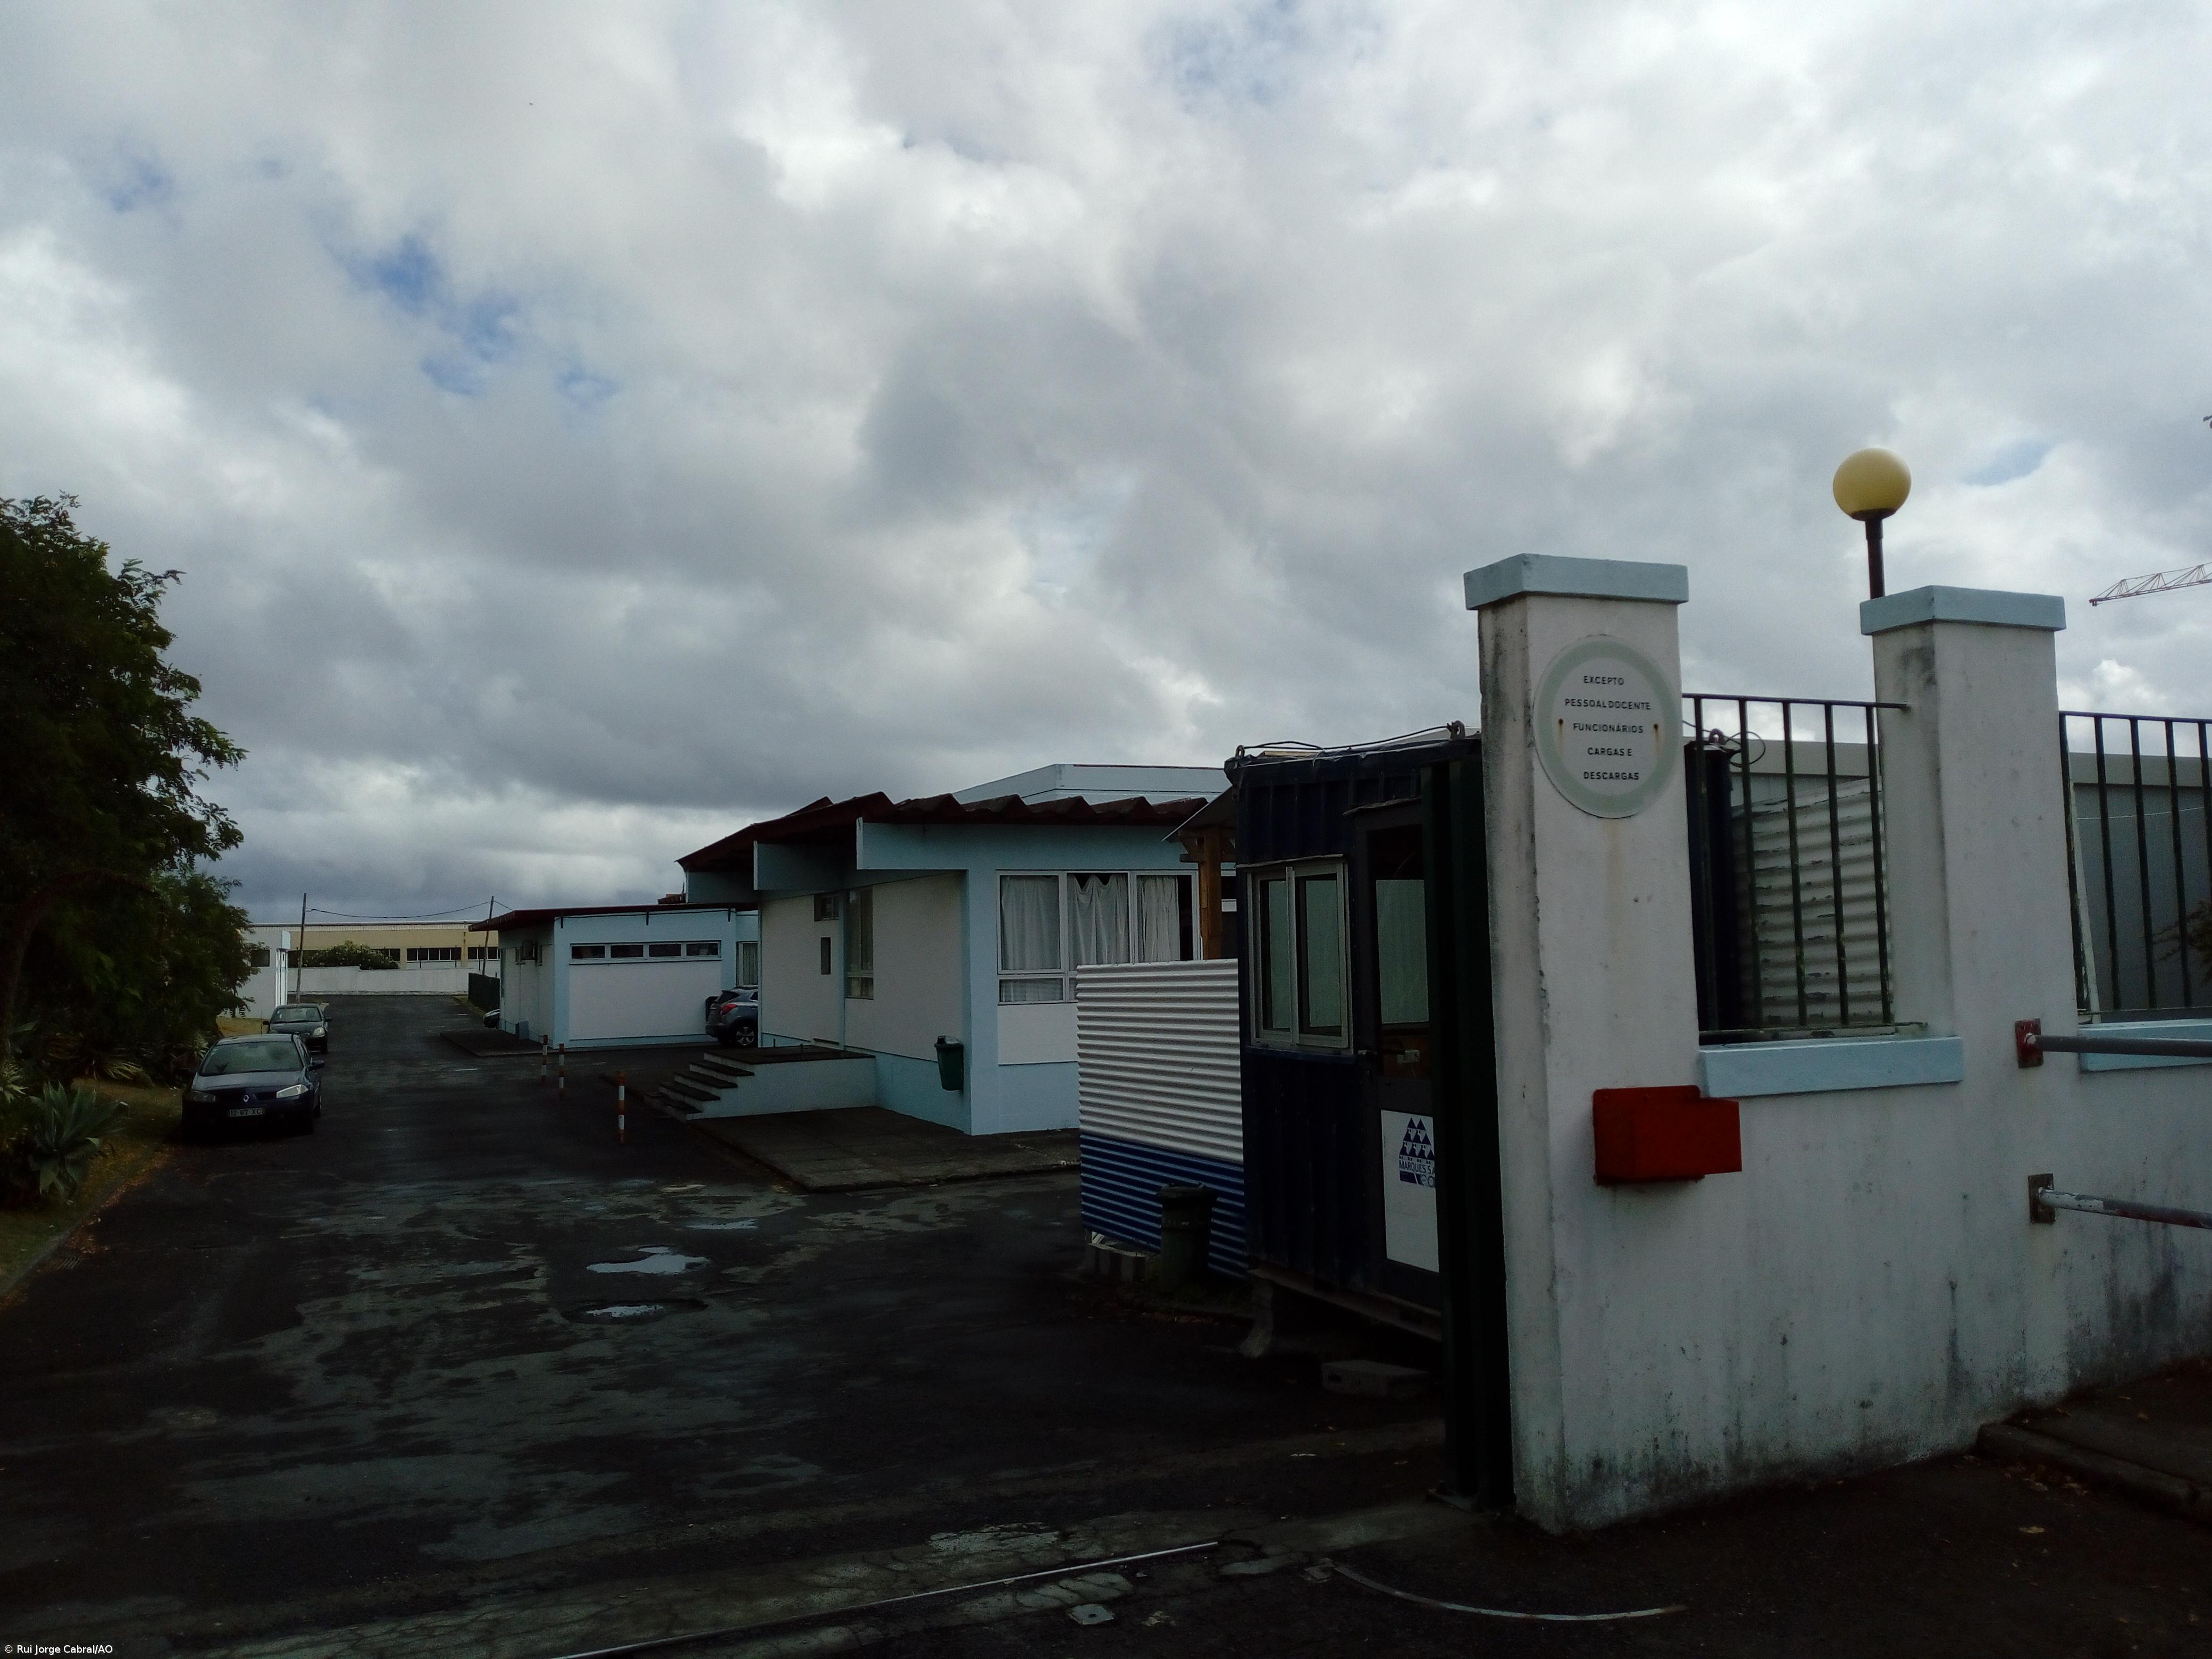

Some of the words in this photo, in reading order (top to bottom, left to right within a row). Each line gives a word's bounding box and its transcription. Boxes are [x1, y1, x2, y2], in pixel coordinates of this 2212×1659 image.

[1583, 675, 1624, 685] EXCEPTO
[1587, 747, 1625, 756] CARGAS
[1627, 748, 1632, 757] E
[1583, 771, 1639, 781] DESCARGAS
[1398, 1160, 1426, 1173] MARQUES
